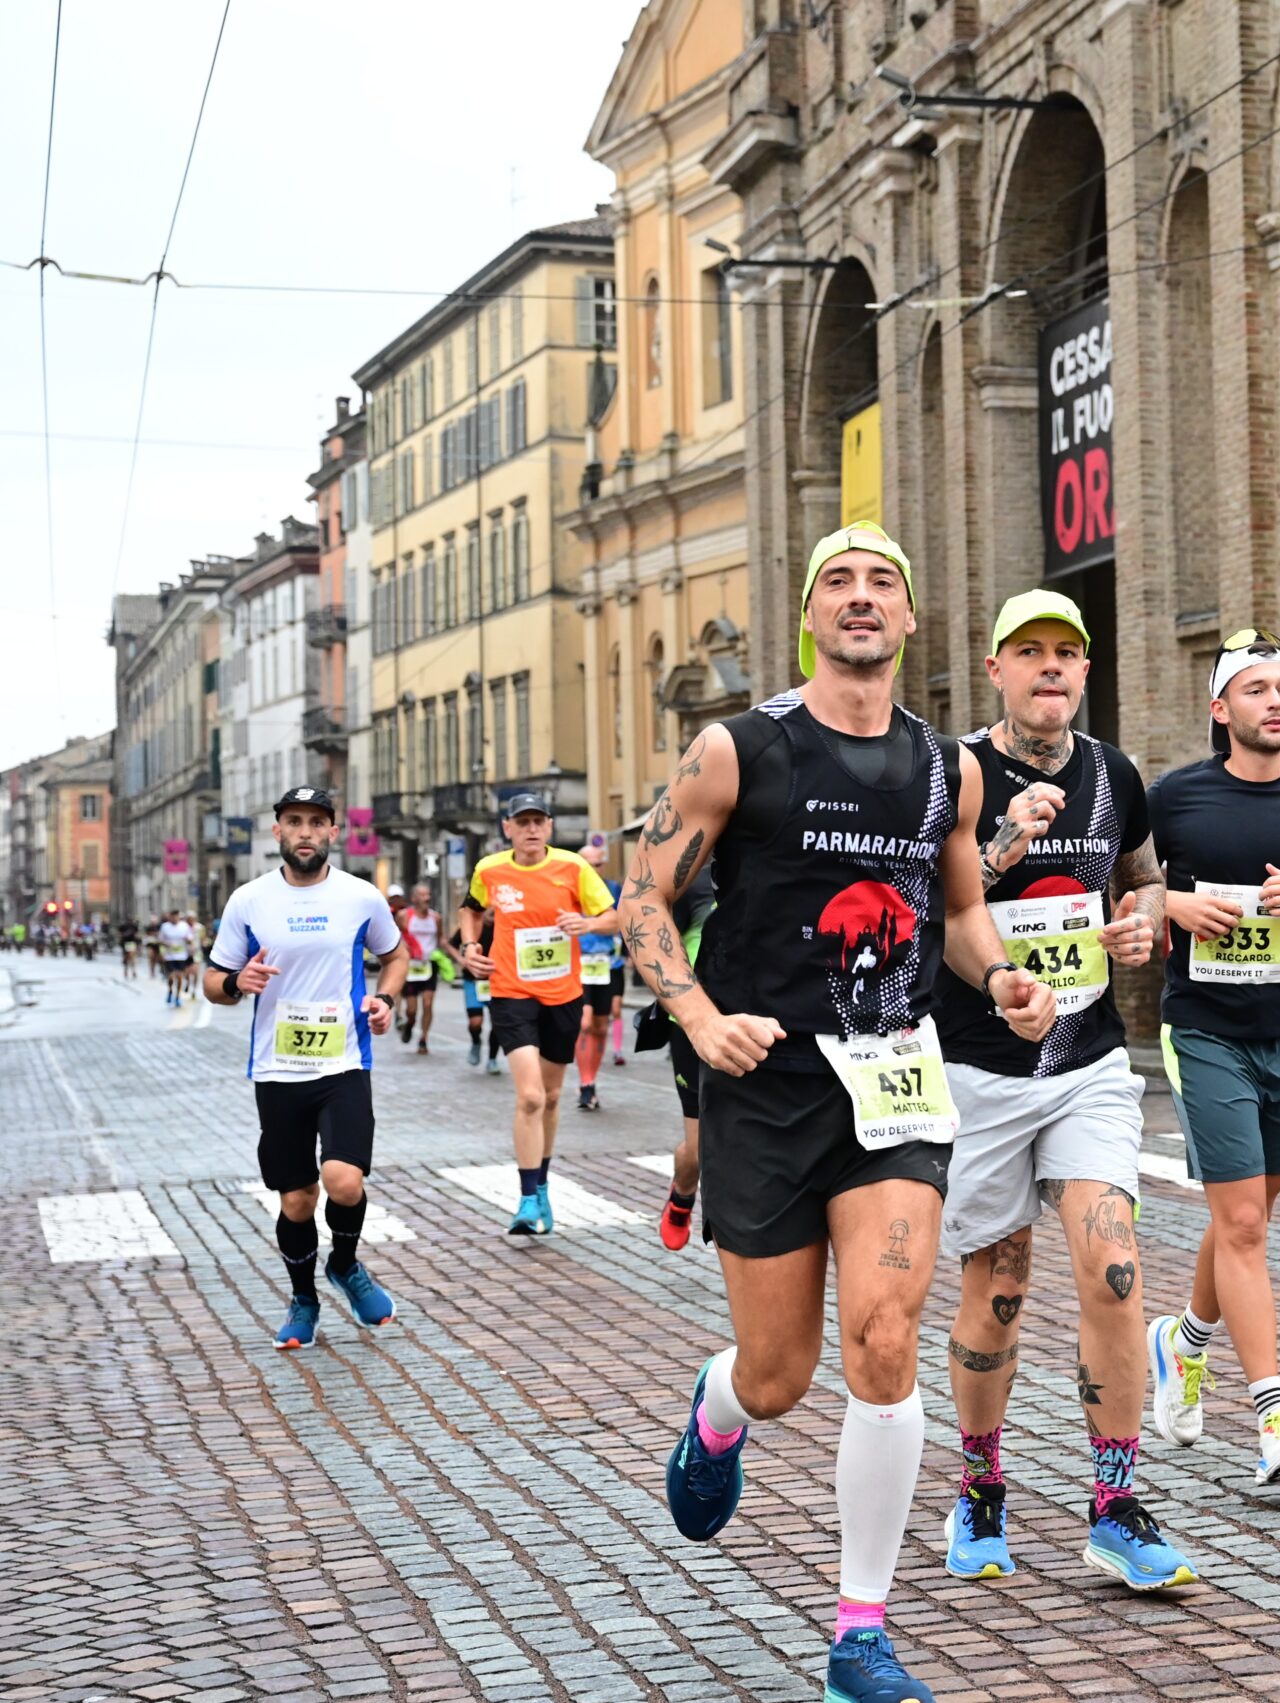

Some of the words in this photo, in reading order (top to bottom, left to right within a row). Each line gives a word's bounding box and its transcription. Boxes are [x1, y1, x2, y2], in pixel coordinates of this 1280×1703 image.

[1051, 408, 1070, 455] IL
[1055, 447, 1117, 554] OR
[819, 802, 859, 812] PISSEI
[1024, 838, 1109, 855] MARATHON
[885, 861, 905, 870] TEAM
[1012, 922, 1046, 933] KING
[1218, 927, 1270, 950] 333
[535, 949, 554, 963] 39
[1024, 943, 1083, 975] 434
[1215, 952, 1271, 962] RICCARDO
[1195, 967, 1212, 975] YOU
[1215, 968, 1253, 977] DESERVE
[292, 1030, 329, 1047] 377
[878, 1068, 922, 1097] 437
[893, 1102, 929, 1114] MATTEO
[863, 1127, 885, 1138] YOU
[889, 1123, 926, 1136] DESERVE
[1091, 1445, 1133, 1465] BAN
